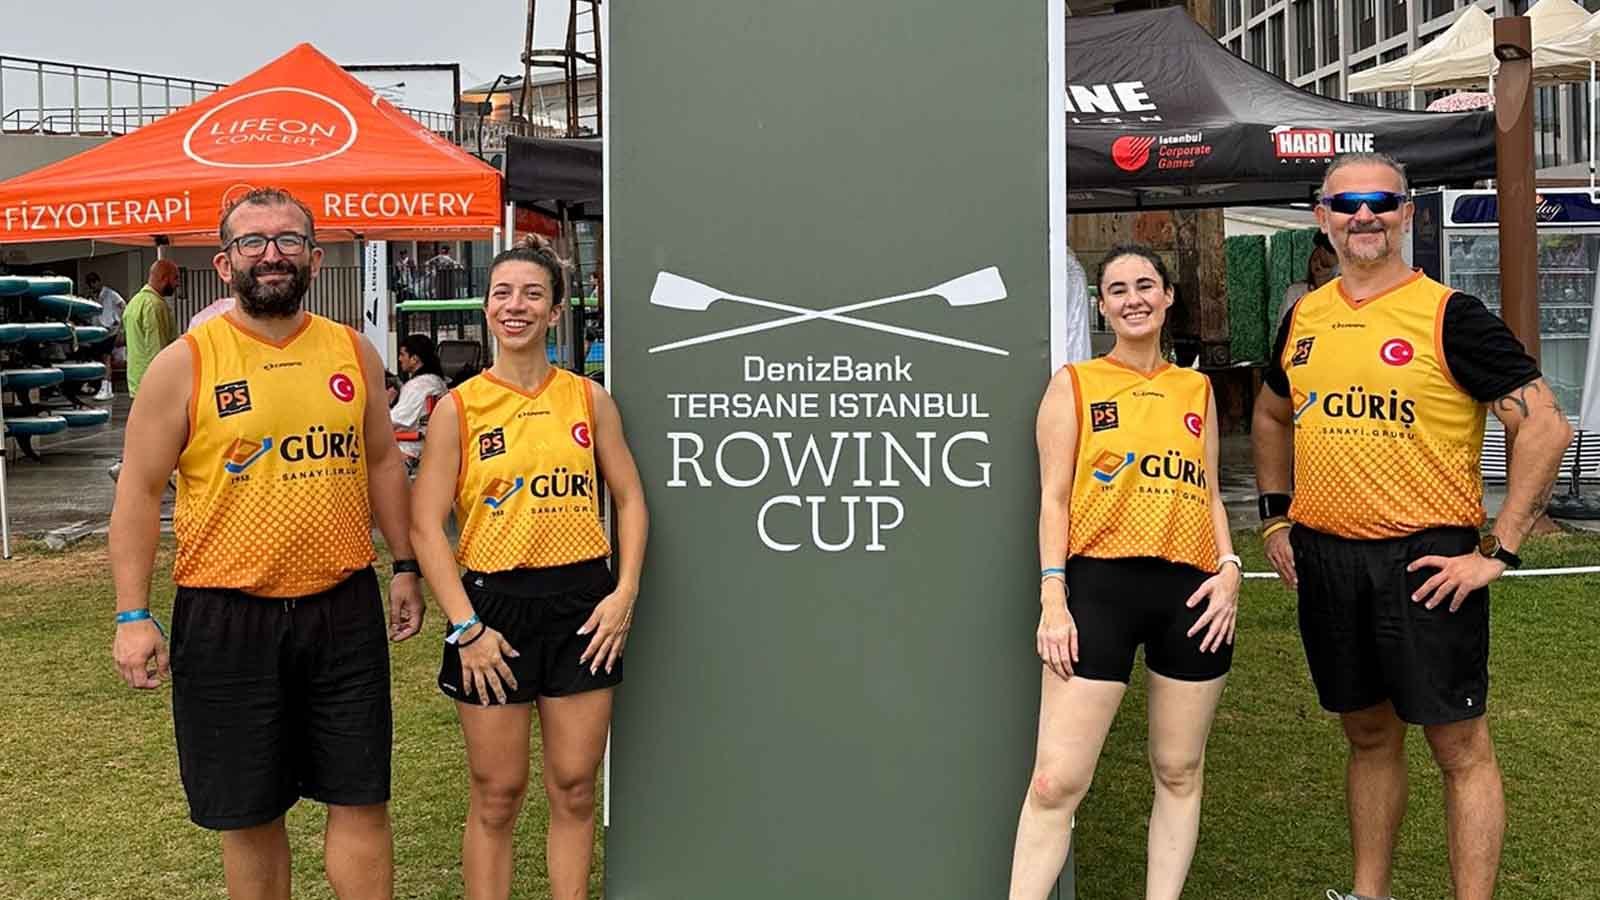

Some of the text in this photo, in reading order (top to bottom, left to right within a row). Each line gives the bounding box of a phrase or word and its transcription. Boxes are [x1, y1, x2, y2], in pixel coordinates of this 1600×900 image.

[210, 117, 336, 137] LIFEON
[214, 133, 321, 147] CONCEPT
[1158, 145, 1212, 158] Corporate
[1157, 158, 1195, 169] Games
[5, 190, 191, 232] FİZYOTERAPİ
[324, 192, 475, 218] RECOVERY
[743, 355, 913, 382] DenizBank
[219, 389, 248, 410] PS
[667, 393, 990, 418] TERSANE ISTANBUL
[1322, 385, 1416, 429] GÜRİŞ
[1093, 409, 1116, 426] PS
[482, 435, 503, 454] PS
[666, 431, 992, 488] ROWING
[756, 494, 905, 551] CUP
